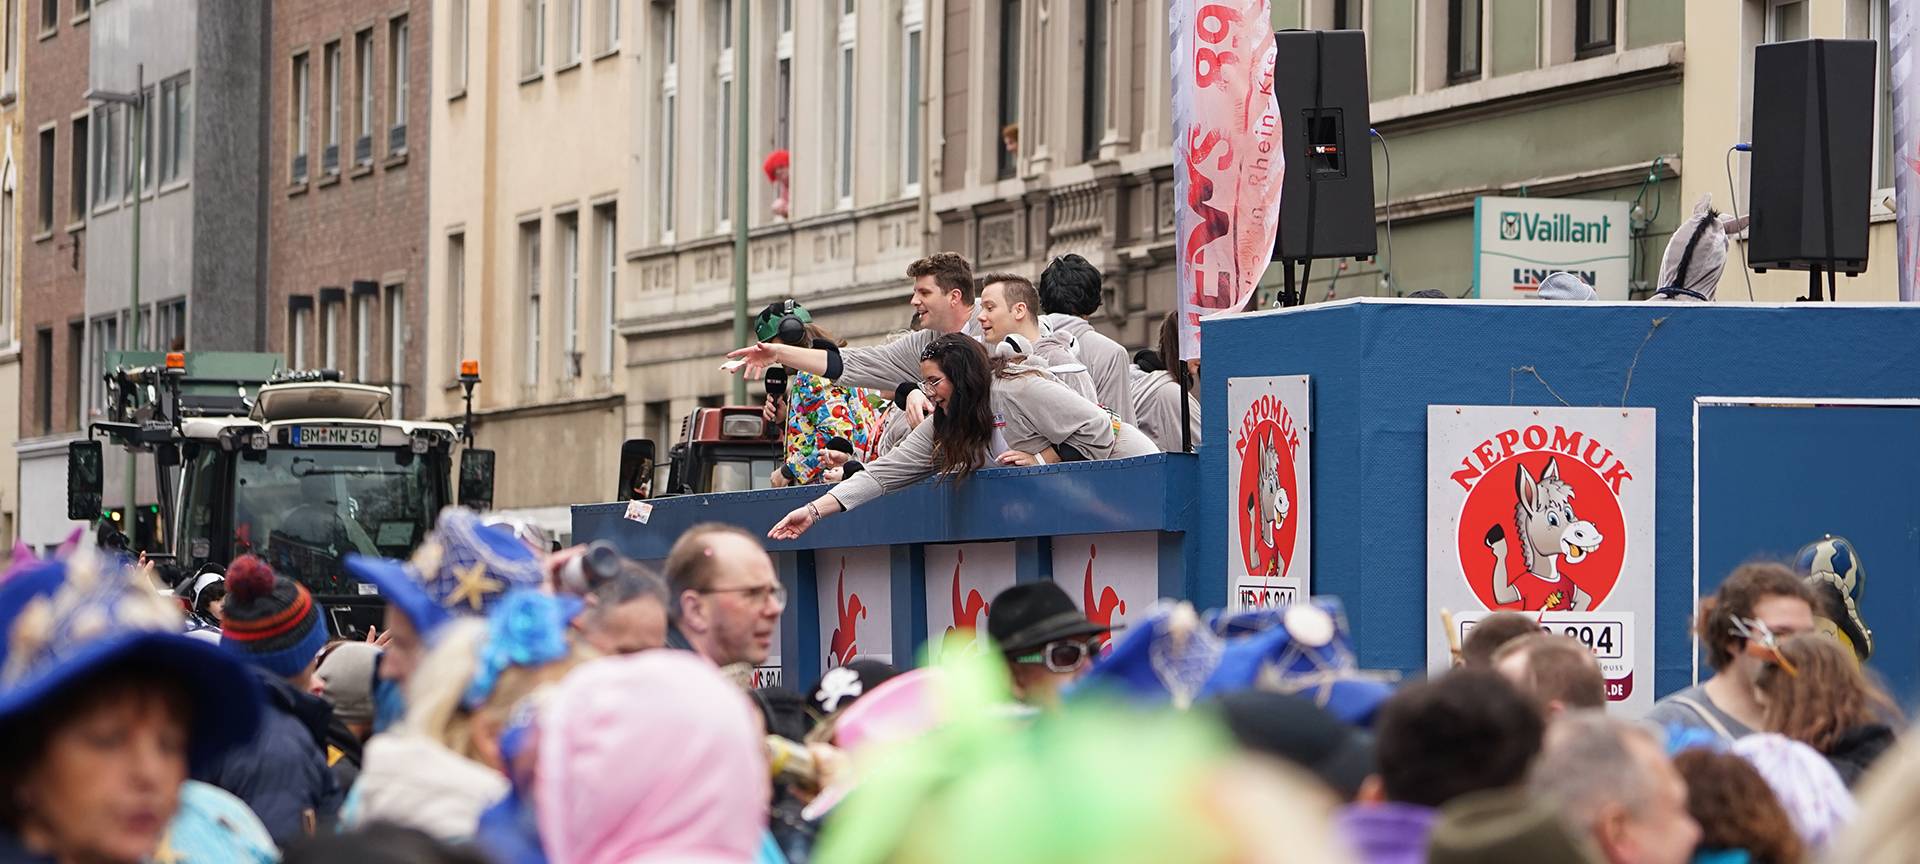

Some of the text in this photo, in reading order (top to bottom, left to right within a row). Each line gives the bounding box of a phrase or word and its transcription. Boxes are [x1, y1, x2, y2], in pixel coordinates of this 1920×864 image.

[1523, 212, 1611, 243] Vaillant
[302, 428, 377, 443] BM MW 516
[1236, 394, 1300, 462] NEPOMUK
[1450, 424, 1633, 496] NEPOMUK
[1600, 662, 1624, 672] euss
